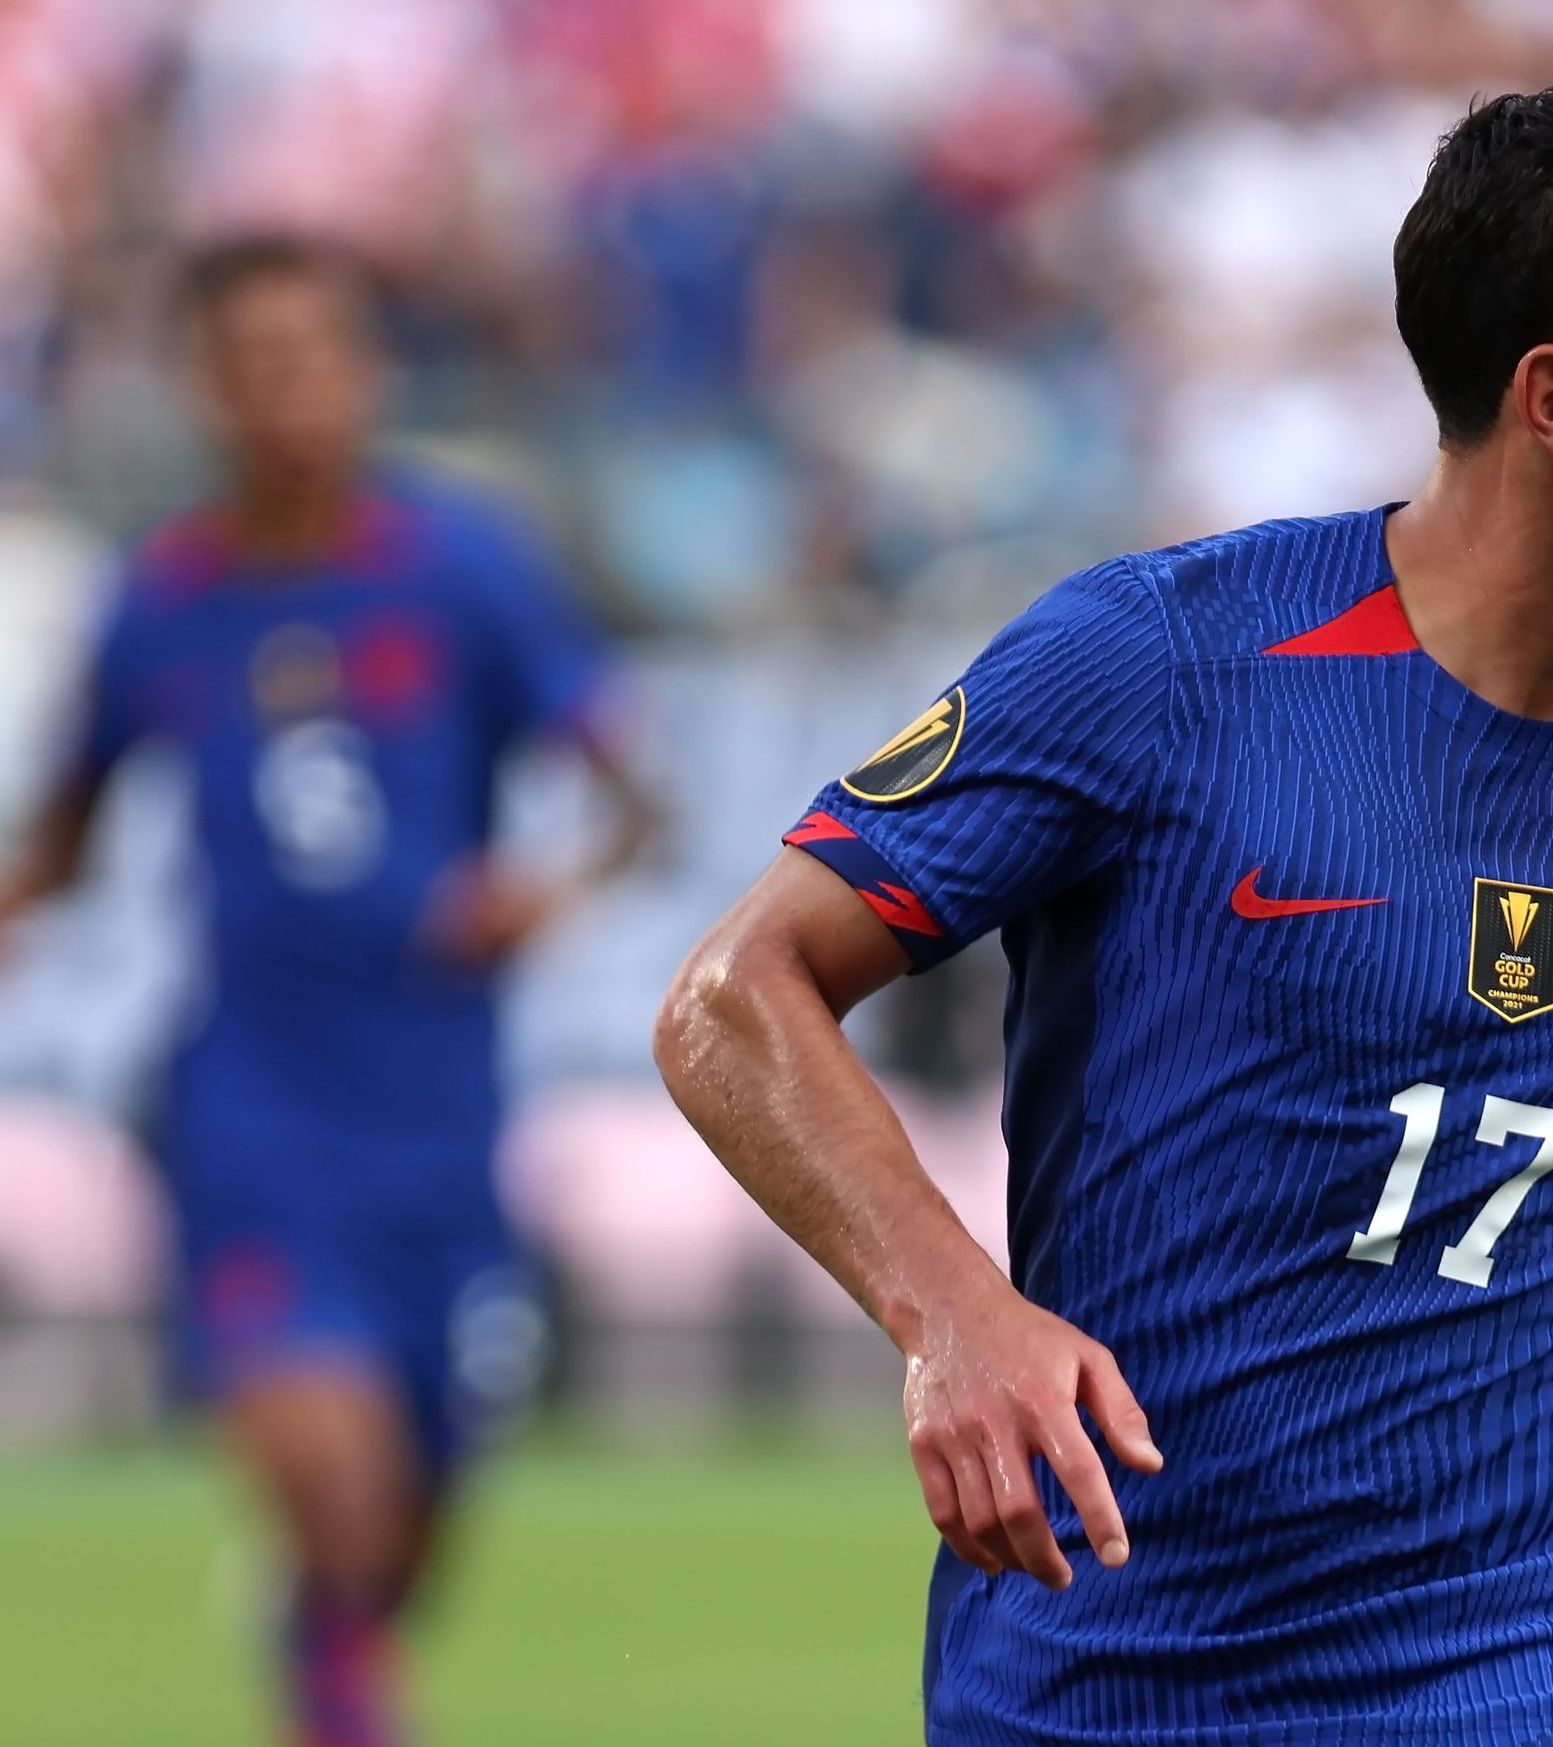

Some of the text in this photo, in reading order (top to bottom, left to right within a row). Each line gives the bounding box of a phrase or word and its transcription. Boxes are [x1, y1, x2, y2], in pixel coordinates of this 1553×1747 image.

[1494, 960, 1536, 977] GOLD
[1499, 973, 1529, 989] CUP
[1488, 989, 1539, 1003] CHAMPIONS
